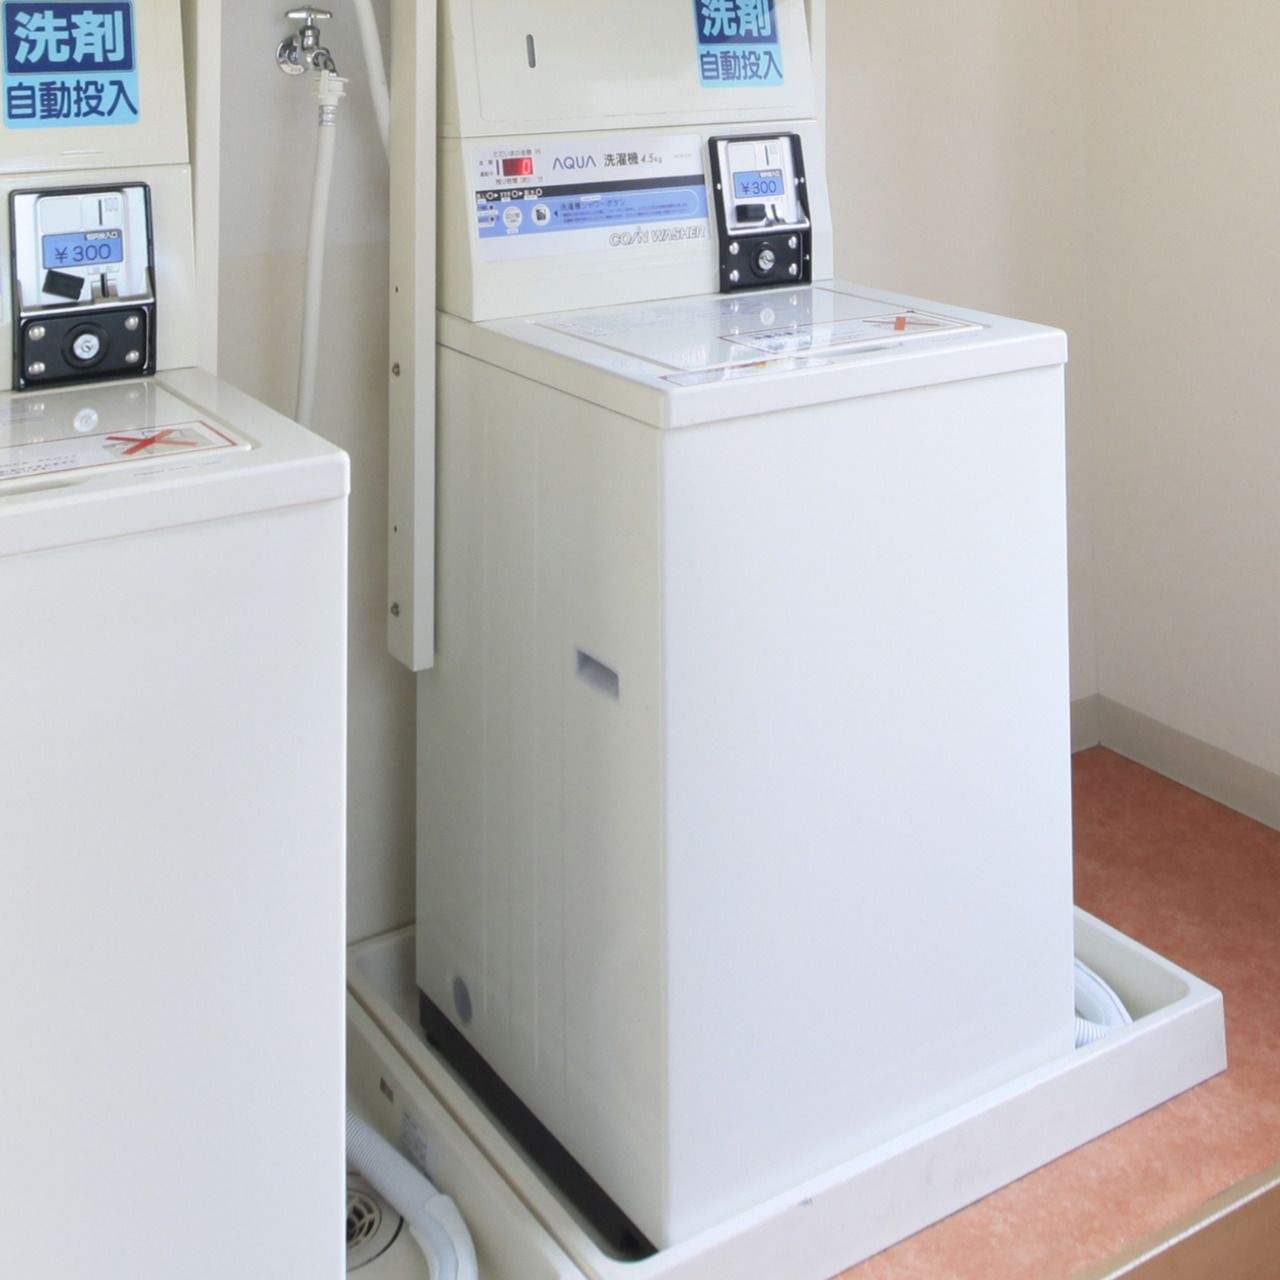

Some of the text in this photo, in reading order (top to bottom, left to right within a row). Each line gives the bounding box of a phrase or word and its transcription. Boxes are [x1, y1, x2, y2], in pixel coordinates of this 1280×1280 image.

[14, 10, 125, 64] 洗剤
[700, 51, 783, 81] 自動投入
[7, 79, 138, 120] 自動投入
[522, 158, 531, 174] 0
[552, 156, 597, 171] AQUA
[604, 152, 639, 167] 洗濯機
[651, 224, 706, 244] WASHER
[55, 244, 112, 263] ¥300
